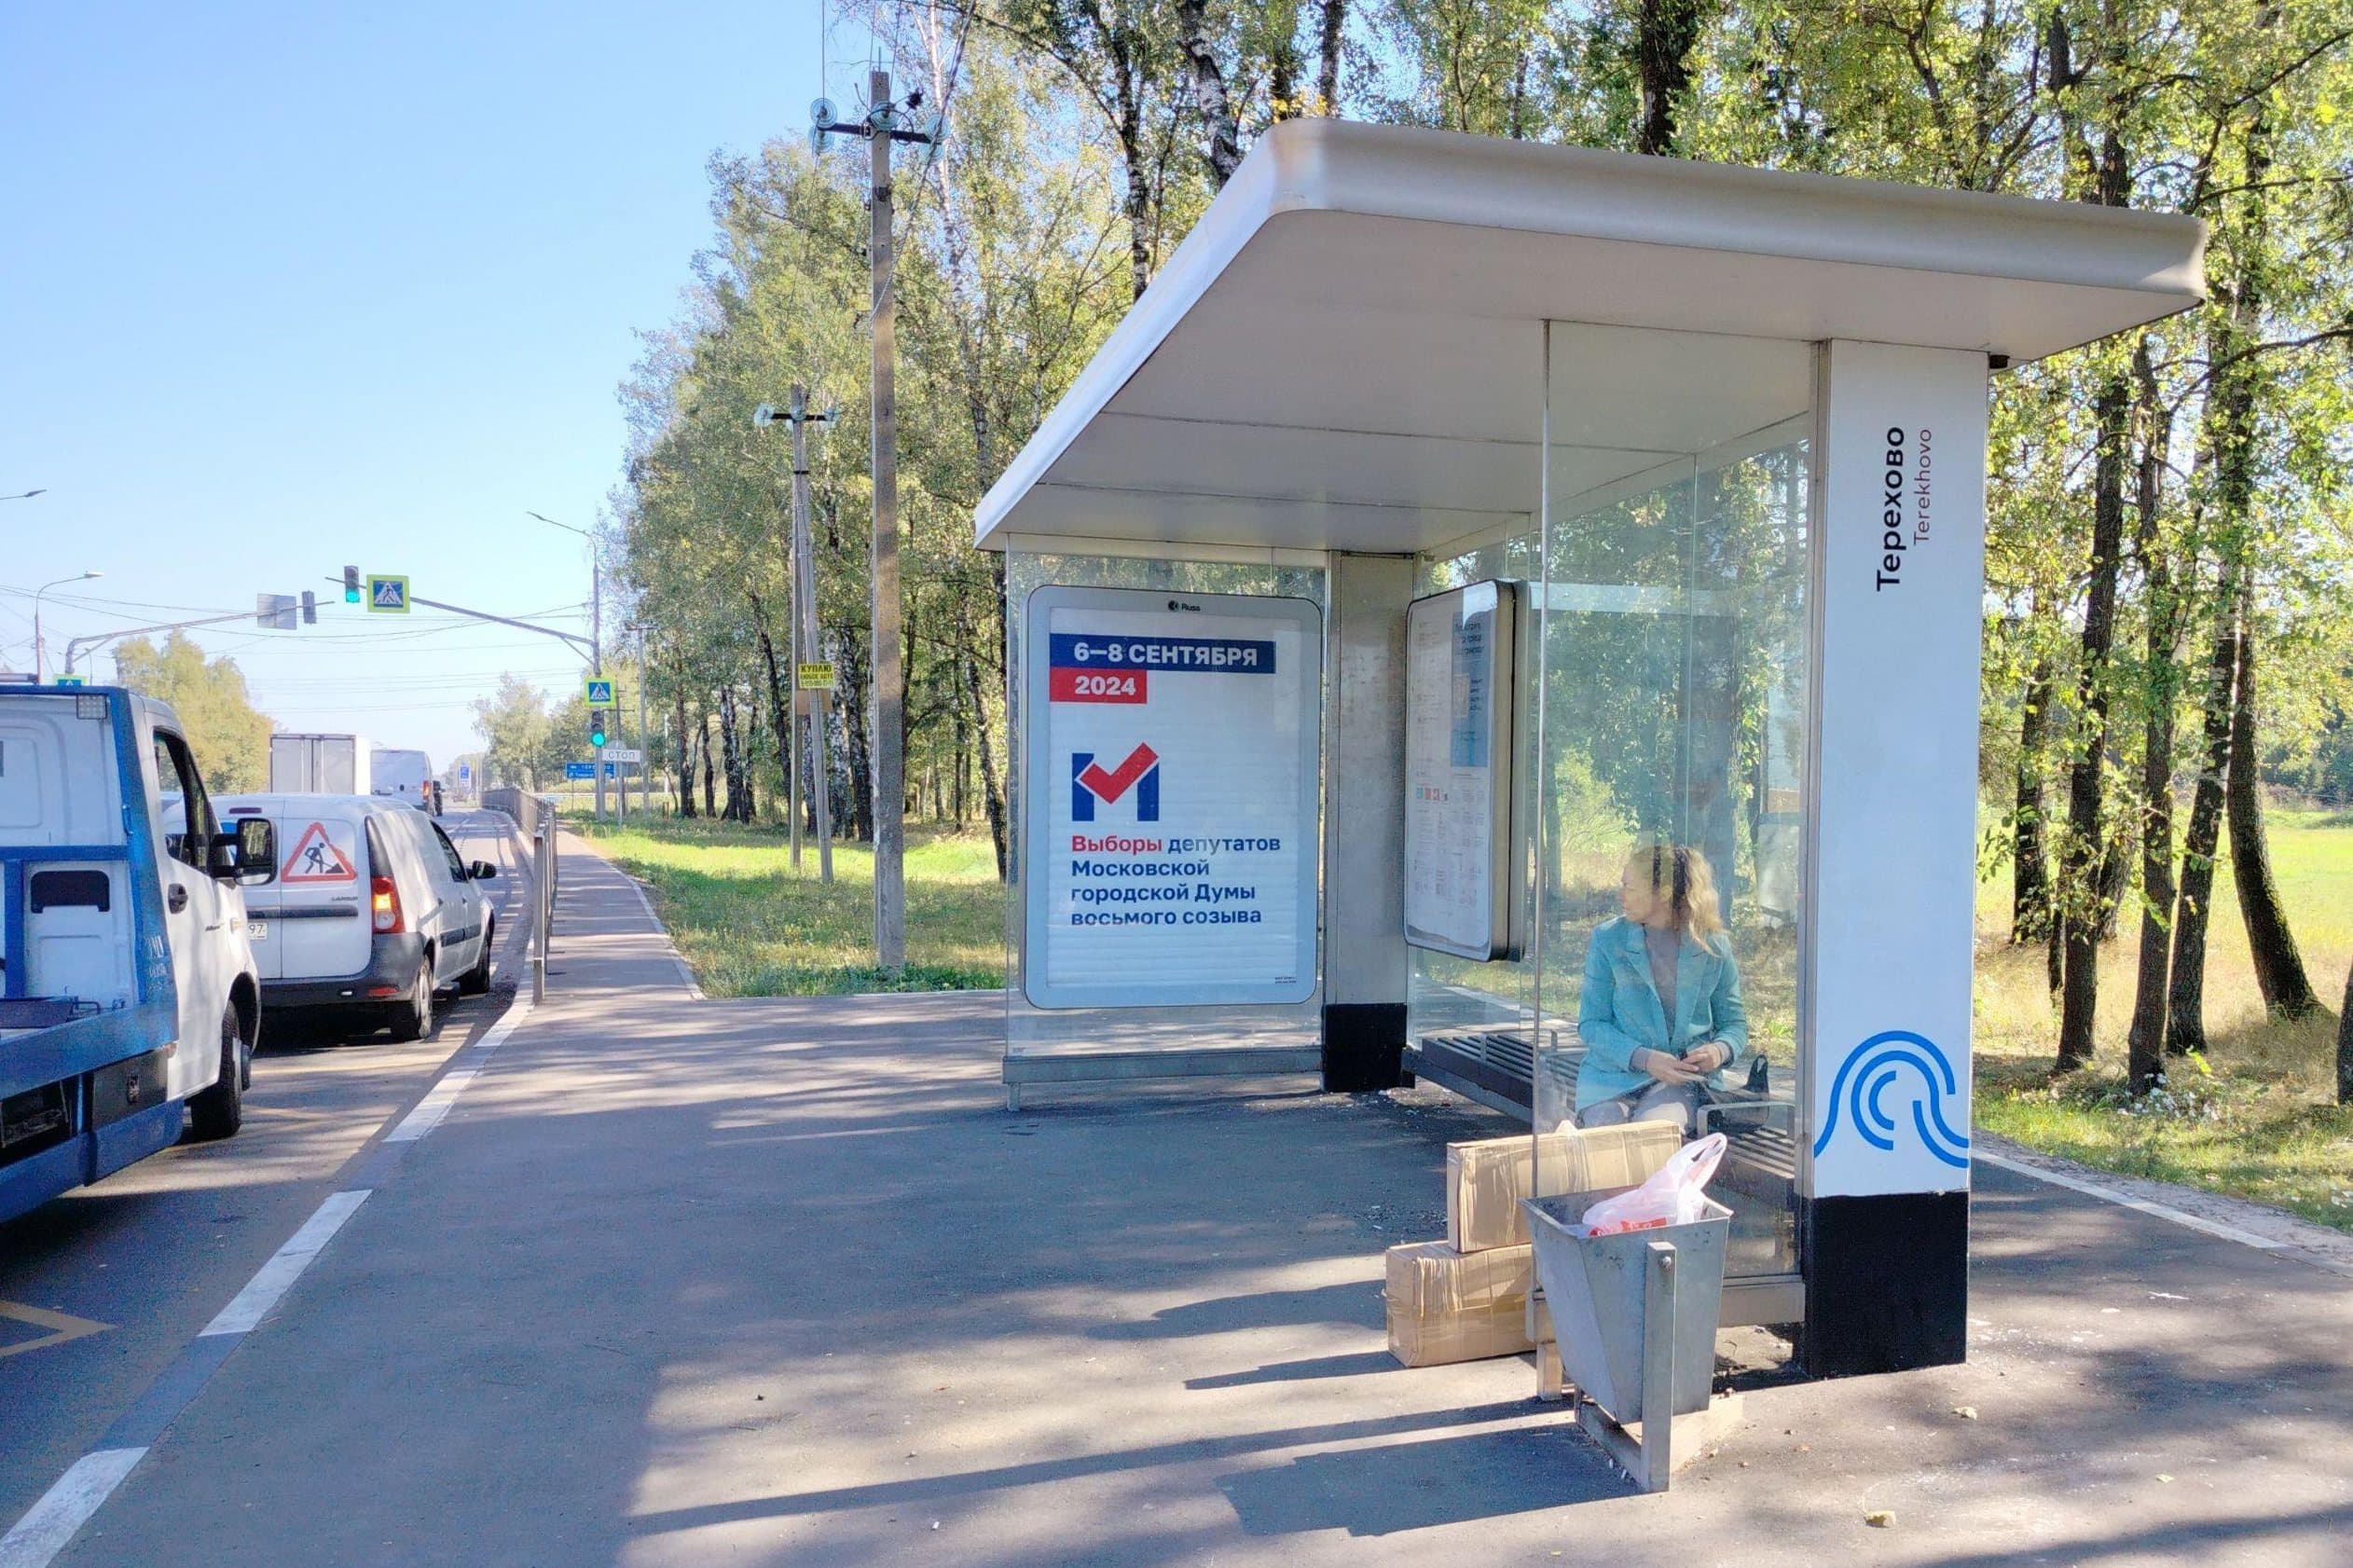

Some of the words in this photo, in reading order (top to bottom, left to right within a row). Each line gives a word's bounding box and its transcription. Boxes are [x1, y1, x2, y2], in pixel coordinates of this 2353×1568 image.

[1914, 429, 1933, 546] Terekhovo
[1876, 426, 1906, 592] Терехово
[1128, 644, 1257, 666] СЕНТЯБРЯ
[1074, 675, 1136, 695] 2024
[608, 750, 636, 760] СТОП
[1071, 835, 1163, 855] Выборы
[1168, 837, 1281, 855] депутатов
[1071, 859, 1209, 876] Московской
[1071, 883, 1189, 905] городской
[1194, 884, 1256, 903] Думы
[1071, 911, 1176, 926] восьмого
[1182, 910, 1261, 925] созыва
